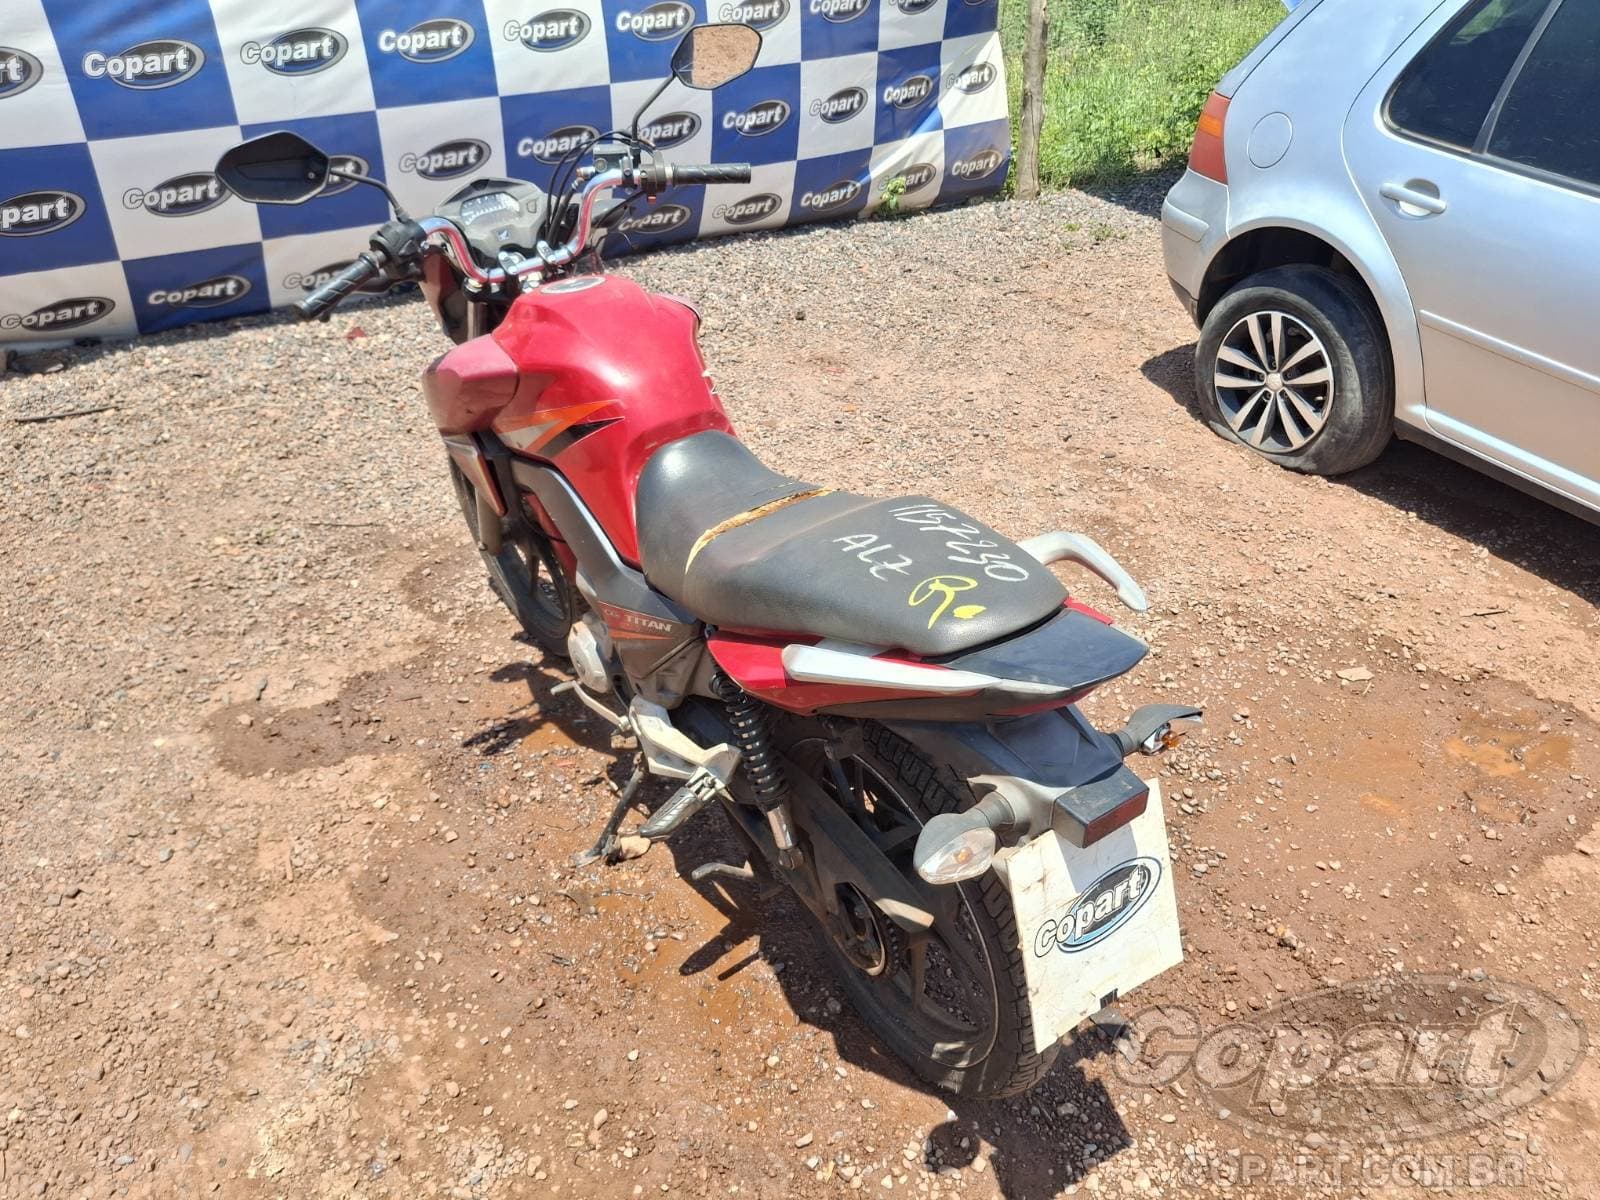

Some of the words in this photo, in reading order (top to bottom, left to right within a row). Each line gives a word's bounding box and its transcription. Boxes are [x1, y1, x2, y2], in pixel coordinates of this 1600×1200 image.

[616, 6, 686, 32] Copart
[719, 0, 783, 22] Copart
[378, 25, 463, 54] Copart
[504, 14, 580, 41] Copart
[83, 47, 190, 80] Copart
[240, 36, 334, 65] Copart
[946, 66, 990, 90] Copart
[884, 80, 929, 103] Copart
[723, 103, 783, 129] Copart
[810, 93, 862, 117] Copart
[518, 130, 592, 155] Copart
[399, 146, 481, 173] Copart
[951, 152, 997, 175] Copart
[879, 167, 929, 191] Cart
[123, 177, 220, 209] Copart
[800, 183, 858, 206] Copart
[0, 195, 69, 228] part
[712, 196, 773, 218] Copart
[149, 278, 240, 305] Copart
[0, 301, 99, 329] Copart
[624, 614, 673, 632] TITAN
[1034, 864, 1145, 958] Copart
